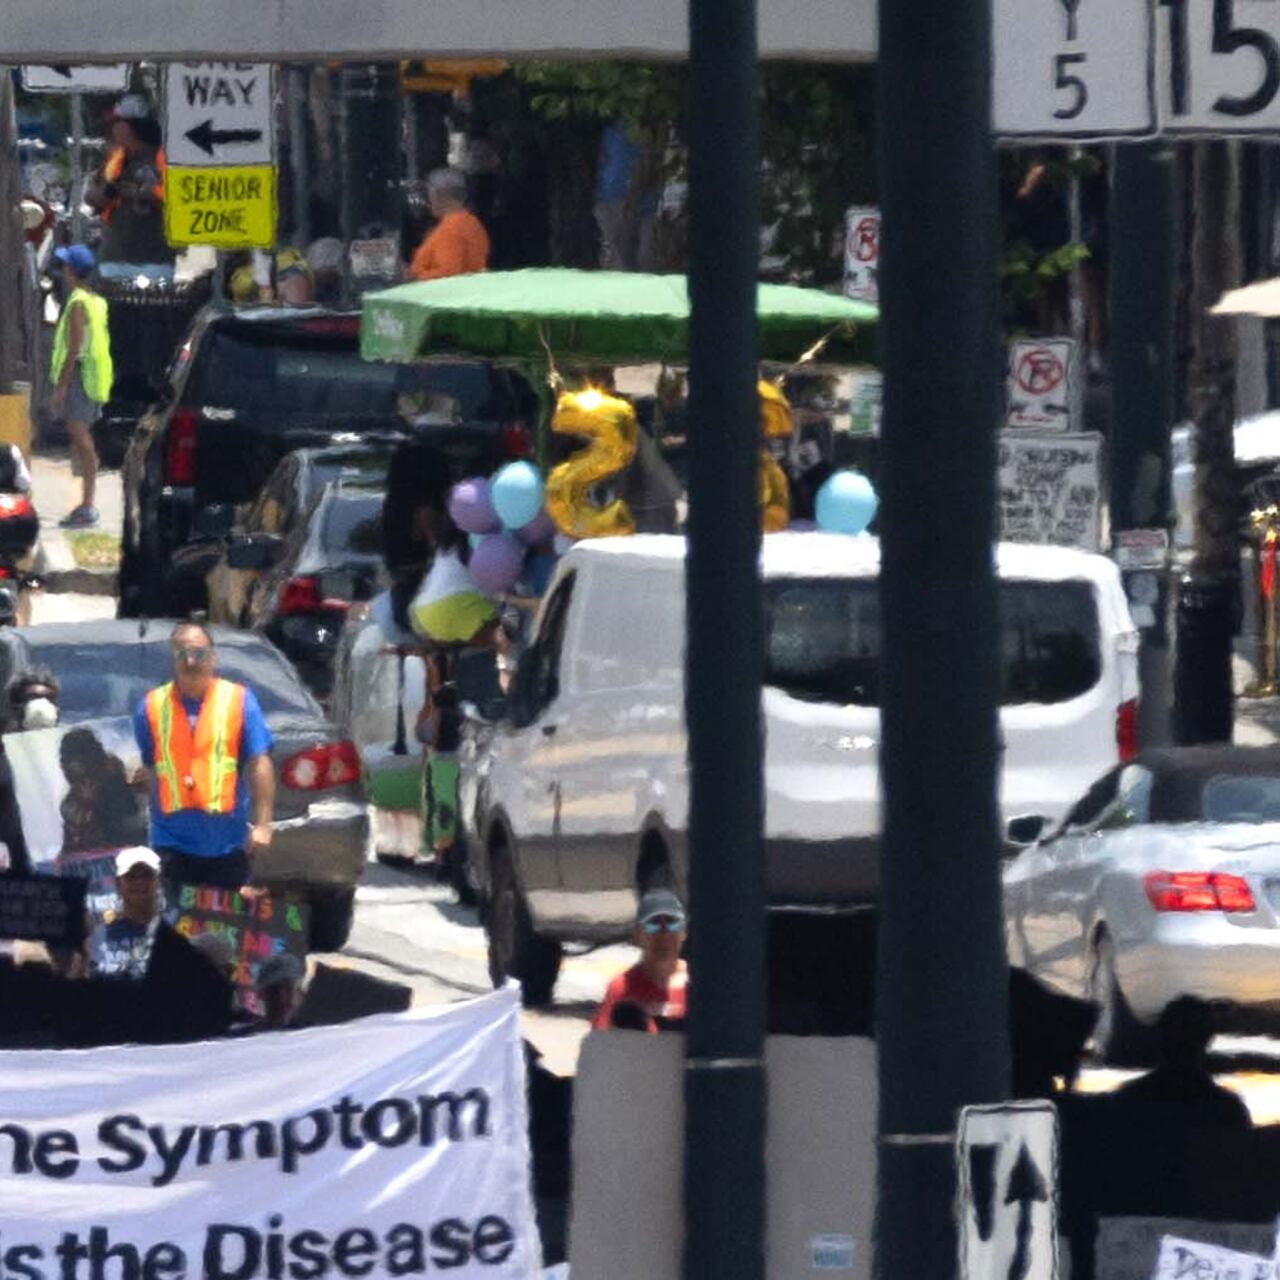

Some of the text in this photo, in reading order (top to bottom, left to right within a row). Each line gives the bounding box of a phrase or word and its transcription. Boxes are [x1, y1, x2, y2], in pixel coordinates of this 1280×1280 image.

[184, 75, 257, 106] WAY
[1052, 53, 1088, 119] 5
[181, 175, 262, 204] SENIOR
[190, 209, 248, 235] ZONE
[96, 1085, 492, 1188] Symptom
